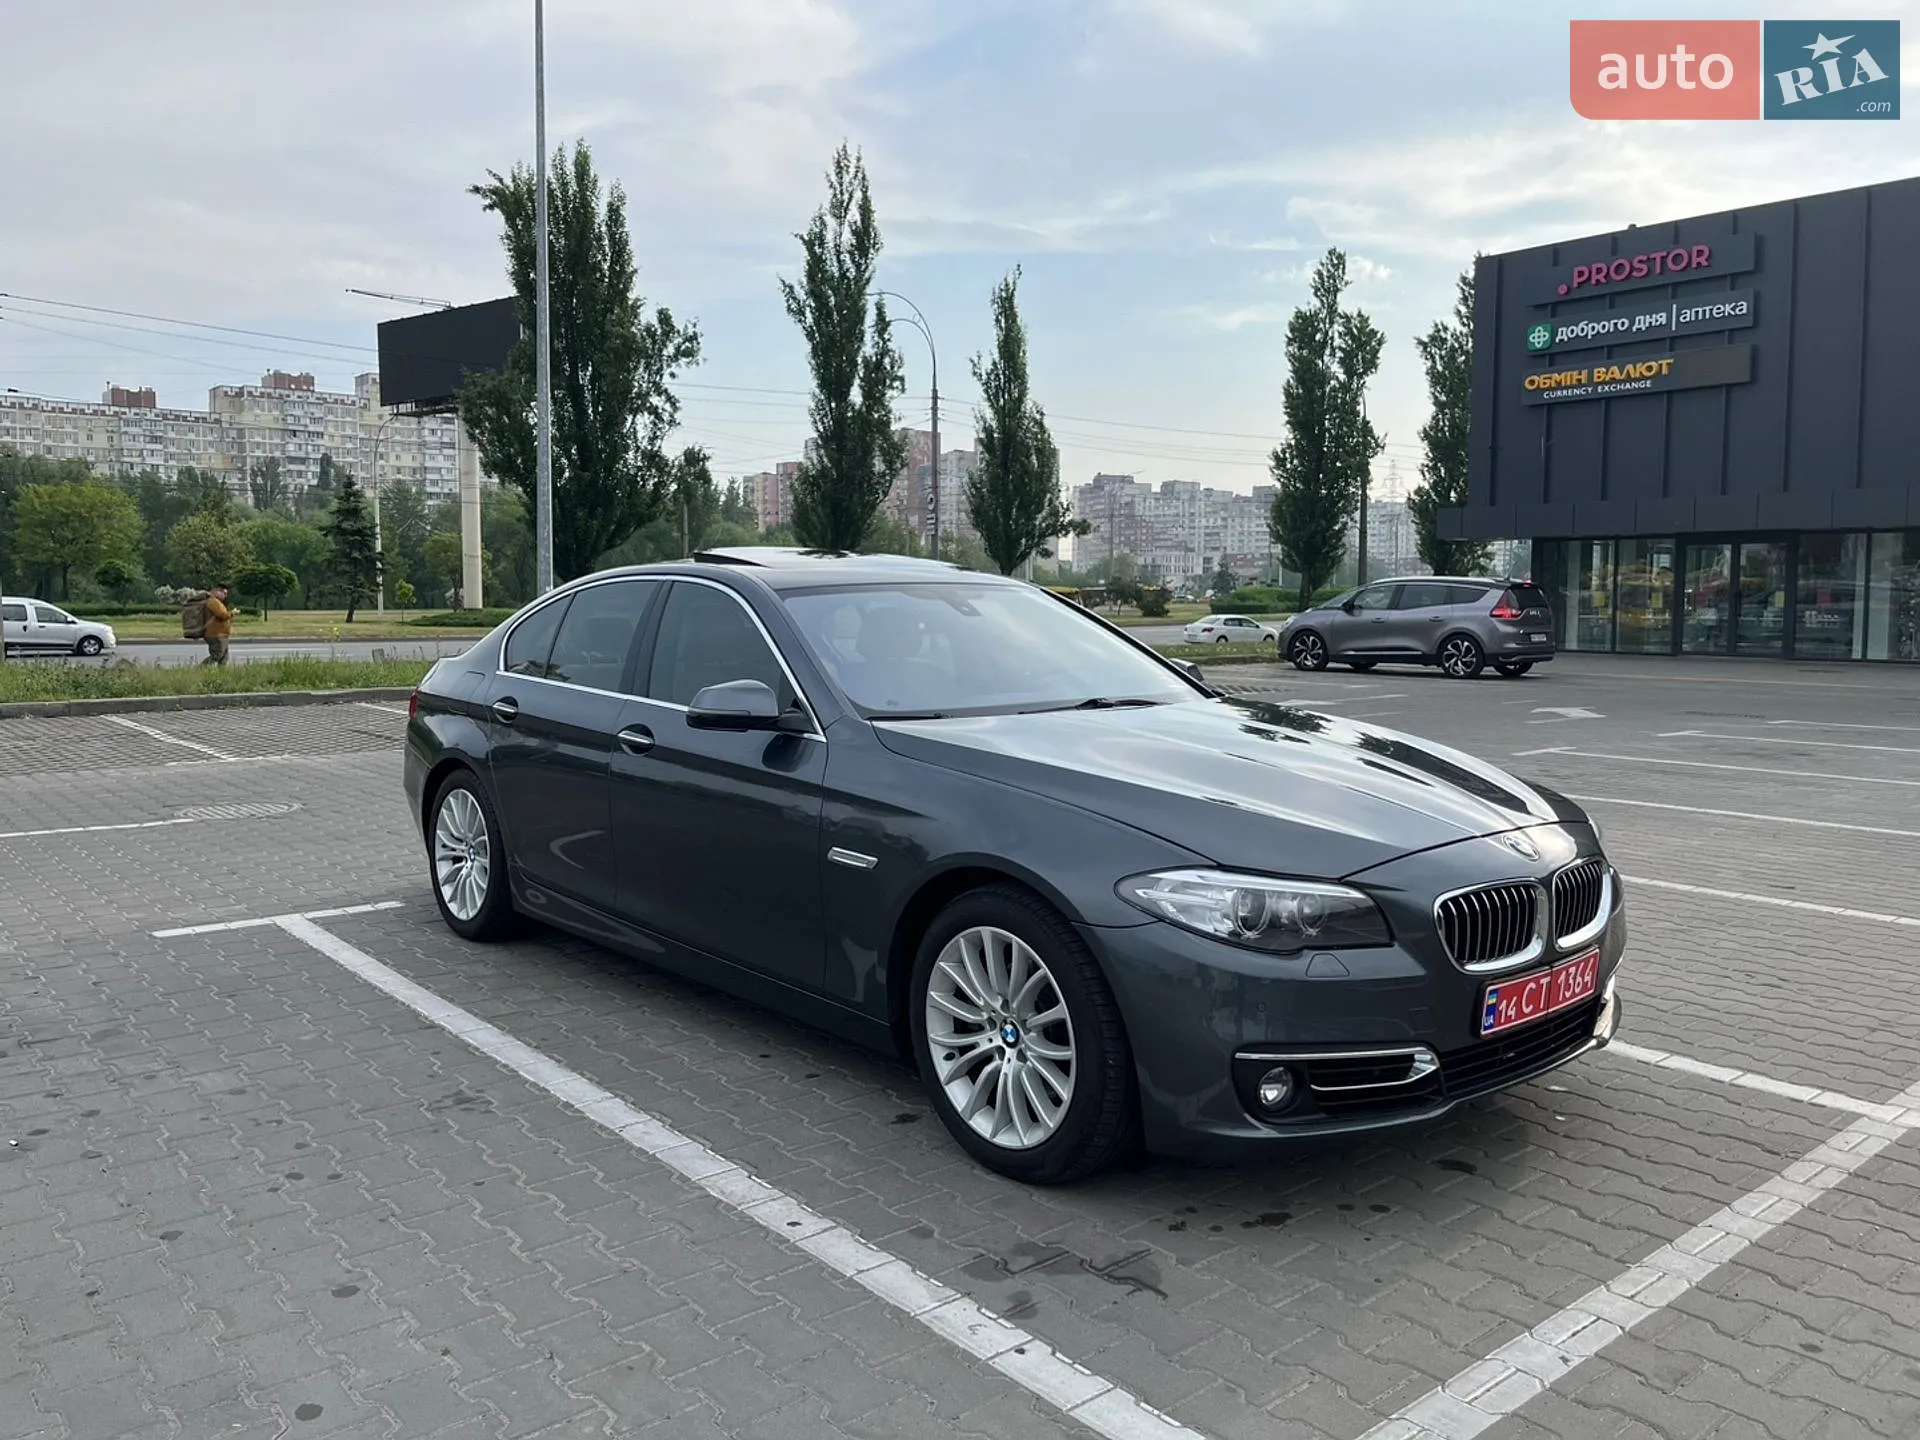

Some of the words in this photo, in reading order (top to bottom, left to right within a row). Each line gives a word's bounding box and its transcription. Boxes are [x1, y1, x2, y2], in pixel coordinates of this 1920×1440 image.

[1555, 317, 1629, 343] доброго
[1632, 311, 1667, 333] дня
[1679, 300, 1748, 323] аптека
[1524, 368, 1588, 390] ОБМІН
[1593, 359, 1674, 381] ВАЛЮТ
[1543, 387, 1593, 399] CURRENCY
[1597, 380, 1652, 393] EXCHANGE
[1557, 958, 1595, 1001] 1364
